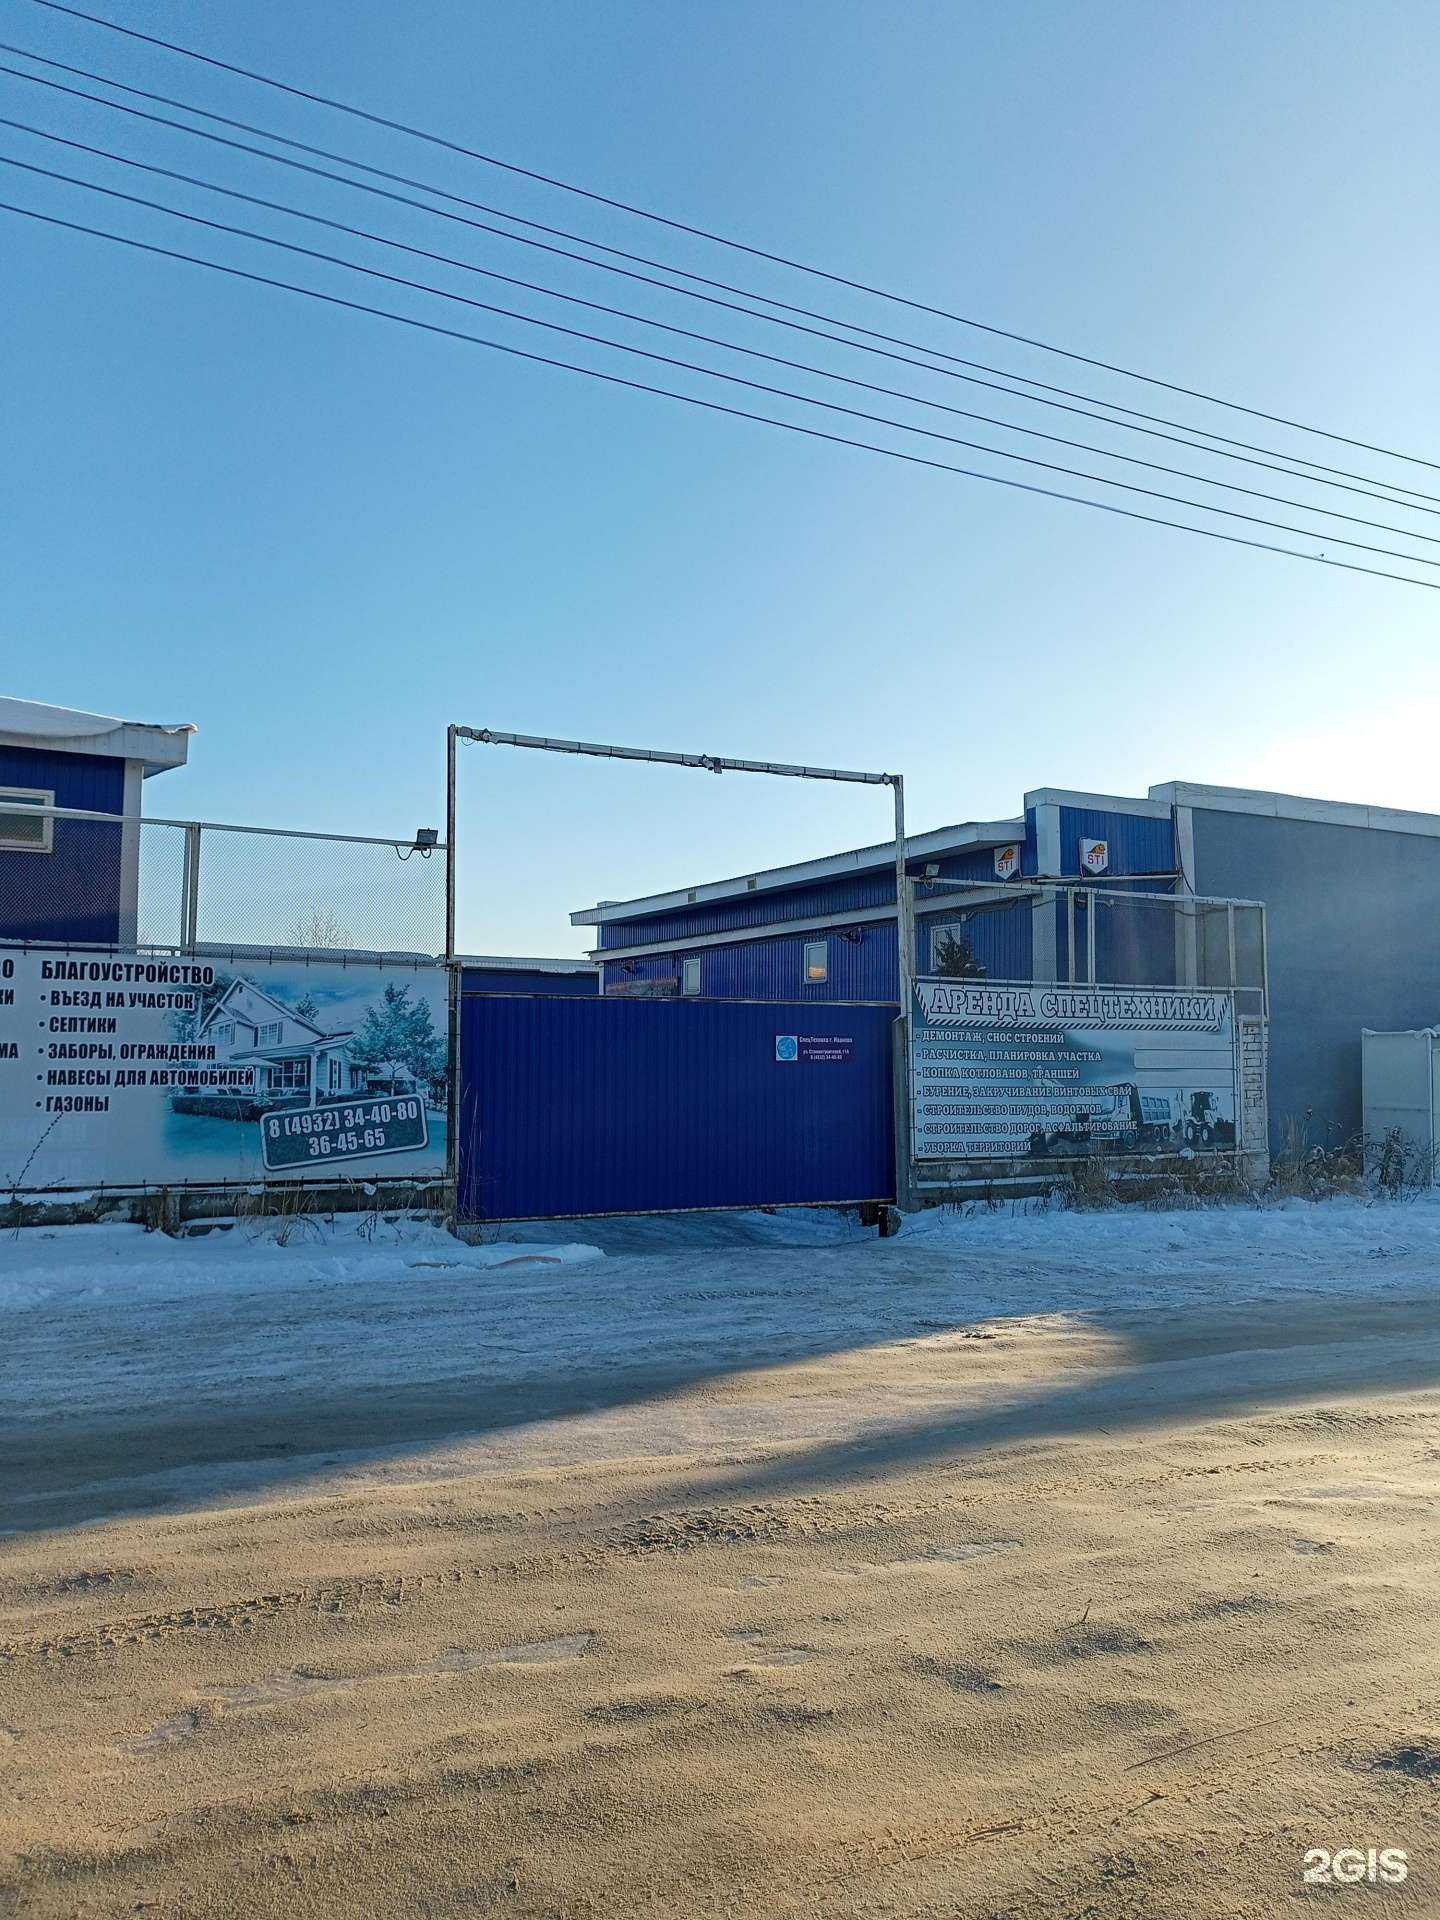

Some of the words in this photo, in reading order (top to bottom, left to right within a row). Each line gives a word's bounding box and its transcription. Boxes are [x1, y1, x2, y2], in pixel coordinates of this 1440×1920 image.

[997, 860, 1013, 872] STI
[1087, 854, 1105, 865] STI
[41, 960, 214, 985] БЛАГОУСТРОЙСТВО
[50, 991, 103, 1009] ВЪЕЗД
[106, 992, 125, 1008] НА
[128, 993, 194, 1009] УЧАСТОК
[929, 988, 1036, 1022] АРЕНДА
[1040, 993, 1217, 1022] СПЕЦТЕХНИКИ
[49, 1016, 117, 1033] СЕПТИКИ
[922, 1031, 986, 1045] ДЕМОНТАЖ,
[986, 1032, 1012, 1043] СНОС
[1014, 1031, 1065, 1044] СТРОЕНИЙ
[48, 1043, 116, 1061] ЗАБОРЫ,
[119, 1044, 216, 1061] ОГРАЖДЕНИЯ
[922, 1050, 987, 1062] РАСЧИСТКА,
[988, 1051, 1056, 1062] ПЛАНИРОВКА
[1057, 1051, 1102, 1062] УЧАСТКА
[47, 1069, 111, 1086] НАВЕСЫ
[114, 1070, 147, 1087] ДЛЯ
[150, 1067, 254, 1086] АВТОМОБИЛЕЙ
[922, 1068, 961, 1079] КОПКА
[962, 1068, 1031, 1080] КОТЛОВАНОВ,
[1032, 1067, 1080, 1080] ТРАНШЕЙ
[922, 1086, 972, 1099] БУРЕНИЕ,
[973, 1086, 1051, 1097] ЗАКРУЧИВАНИЕ
[1053, 1086, 1106, 1097] ВИНТОВЫХ
[1107, 1085, 1132, 1097] СВАЙ
[45, 1096, 110, 1112] ГАЗОНЫ
[923, 1104, 1009, 1116] СТРОИТЕЛЬСТВО
[1010, 1104, 1049, 1117] ПРУДОВ,
[1051, 1104, 1102, 1116] ВОДОЕМОВ
[269, 1119, 281, 1138] 8
[344, 1101, 418, 1128] 34-40-80
[923, 1122, 1010, 1134] СТРОИТЕЛЬСТВО
[1045, 1120, 1138, 1133] АСФАЛЬТИРОВАНИЕ
[309, 1128, 386, 1156] 36-45-65
[924, 1142, 964, 1153] УБОРКА
